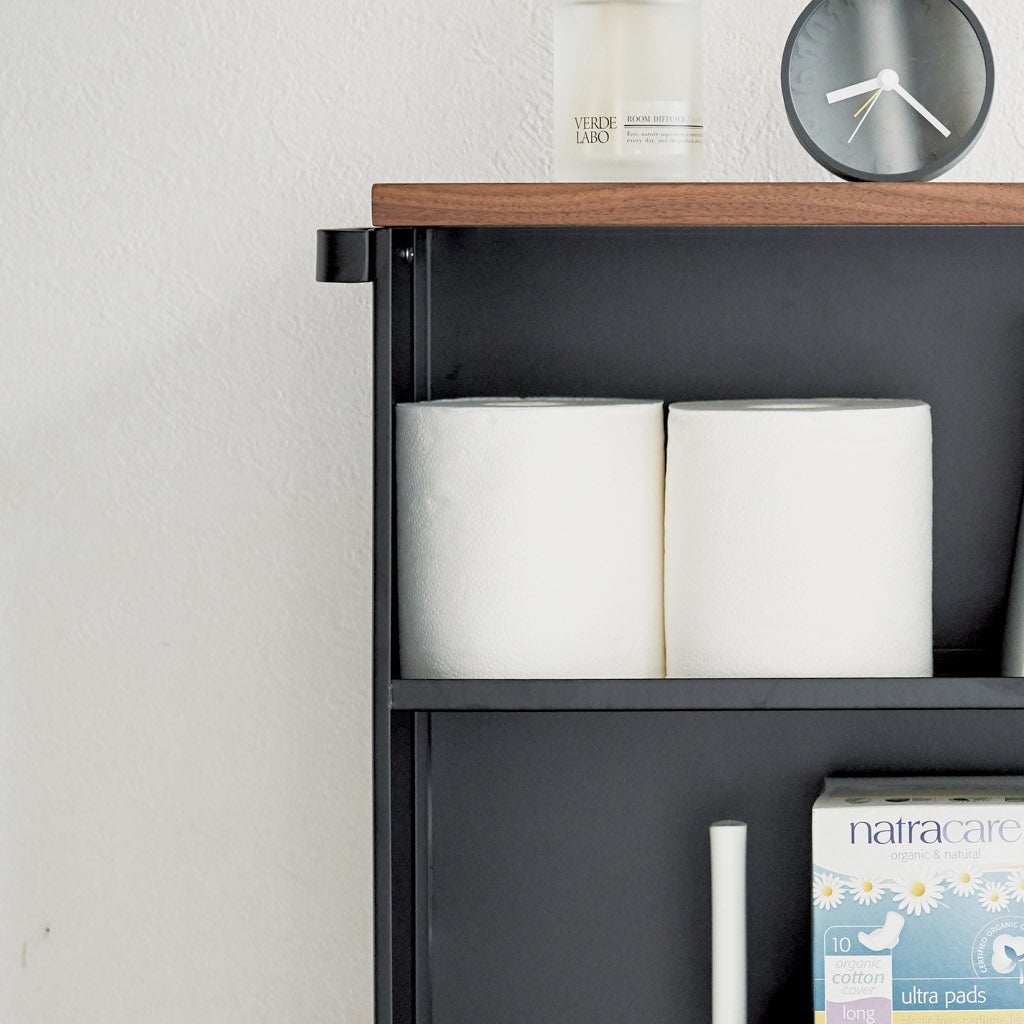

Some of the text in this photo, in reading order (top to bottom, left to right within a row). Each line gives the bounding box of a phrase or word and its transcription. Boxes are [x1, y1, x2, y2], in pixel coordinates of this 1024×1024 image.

[575, 116, 617, 130] VERDE
[576, 130, 610, 144] LABO
[849, 816, 1023, 845] natracare
[890, 849, 982, 864] organic & natural
[832, 936, 851, 953] 10
[977, 936, 988, 974] CERTIFIED
[986, 921, 1019, 937] ORGANIC
[835, 959, 882, 972] organic
[832, 971, 885, 984] cotton
[842, 986, 877, 995] cover
[901, 985, 987, 1008] ultra pads
[842, 1004, 876, 1024] long
